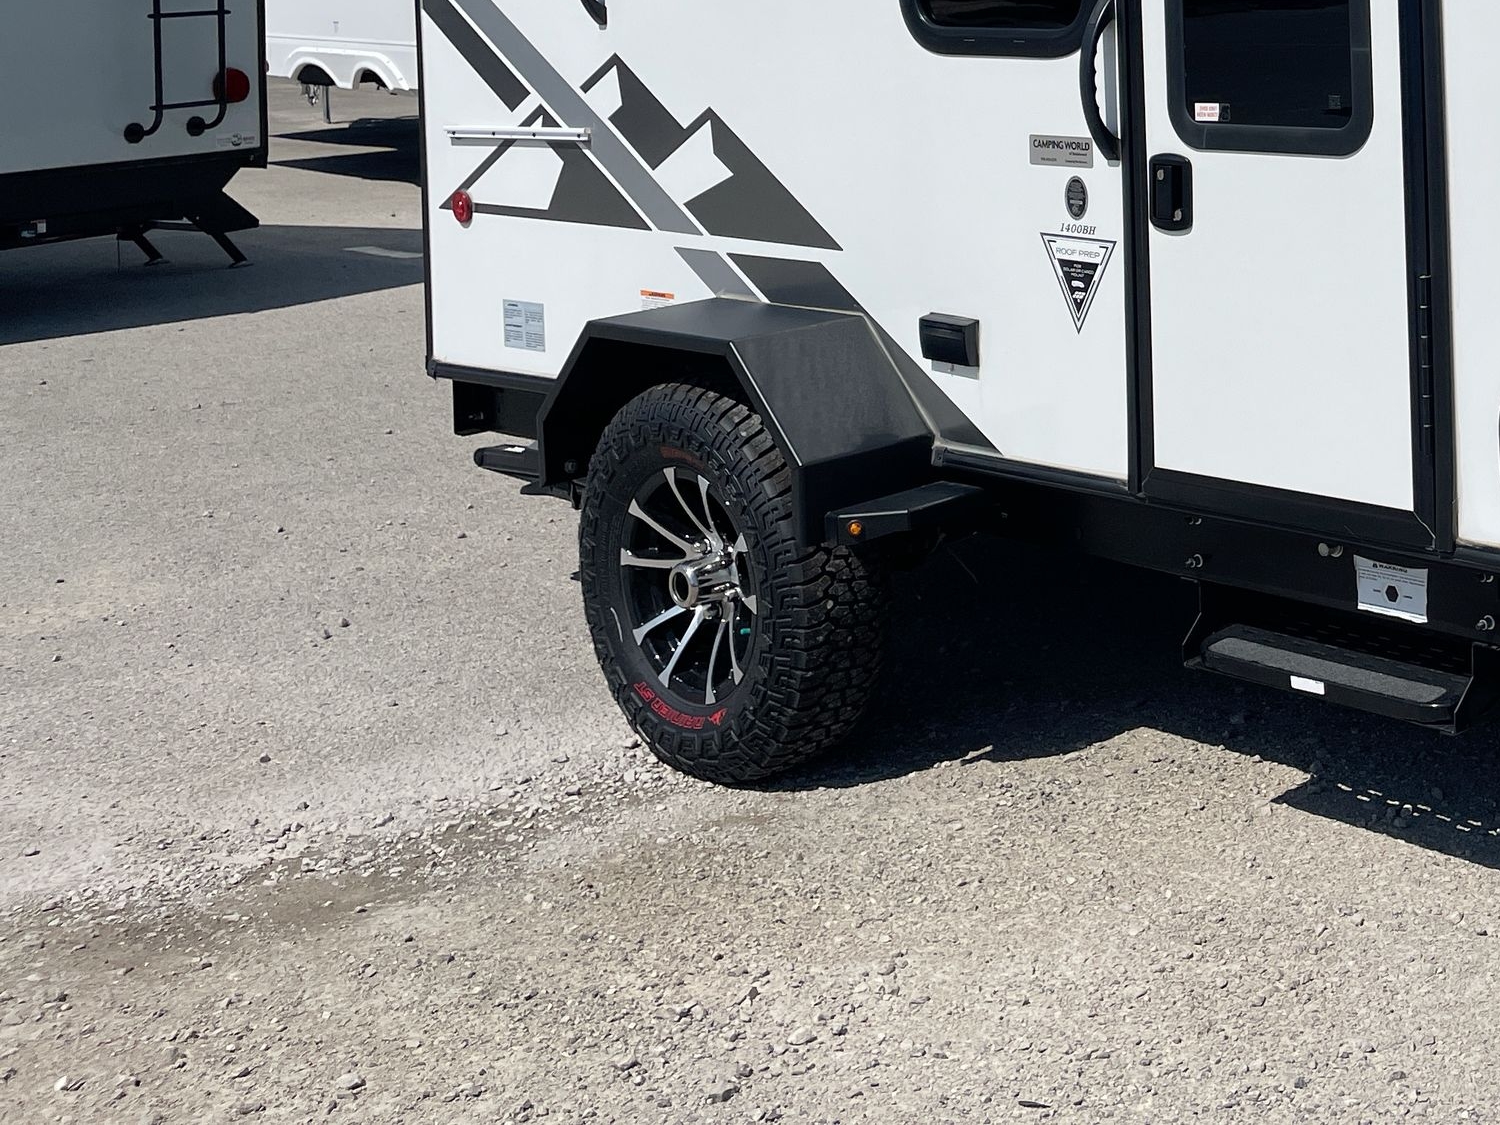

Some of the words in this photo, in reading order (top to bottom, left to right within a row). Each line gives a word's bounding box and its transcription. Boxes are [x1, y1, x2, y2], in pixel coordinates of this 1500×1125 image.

[1032, 139, 1064, 150] CAMPING
[1064, 140, 1090, 151] WORLD
[1060, 223, 1097, 235] 1400BH
[1055, 247, 1077, 256] ROOF
[1078, 249, 1101, 259] PREP
[633, 681, 656, 703] ST
